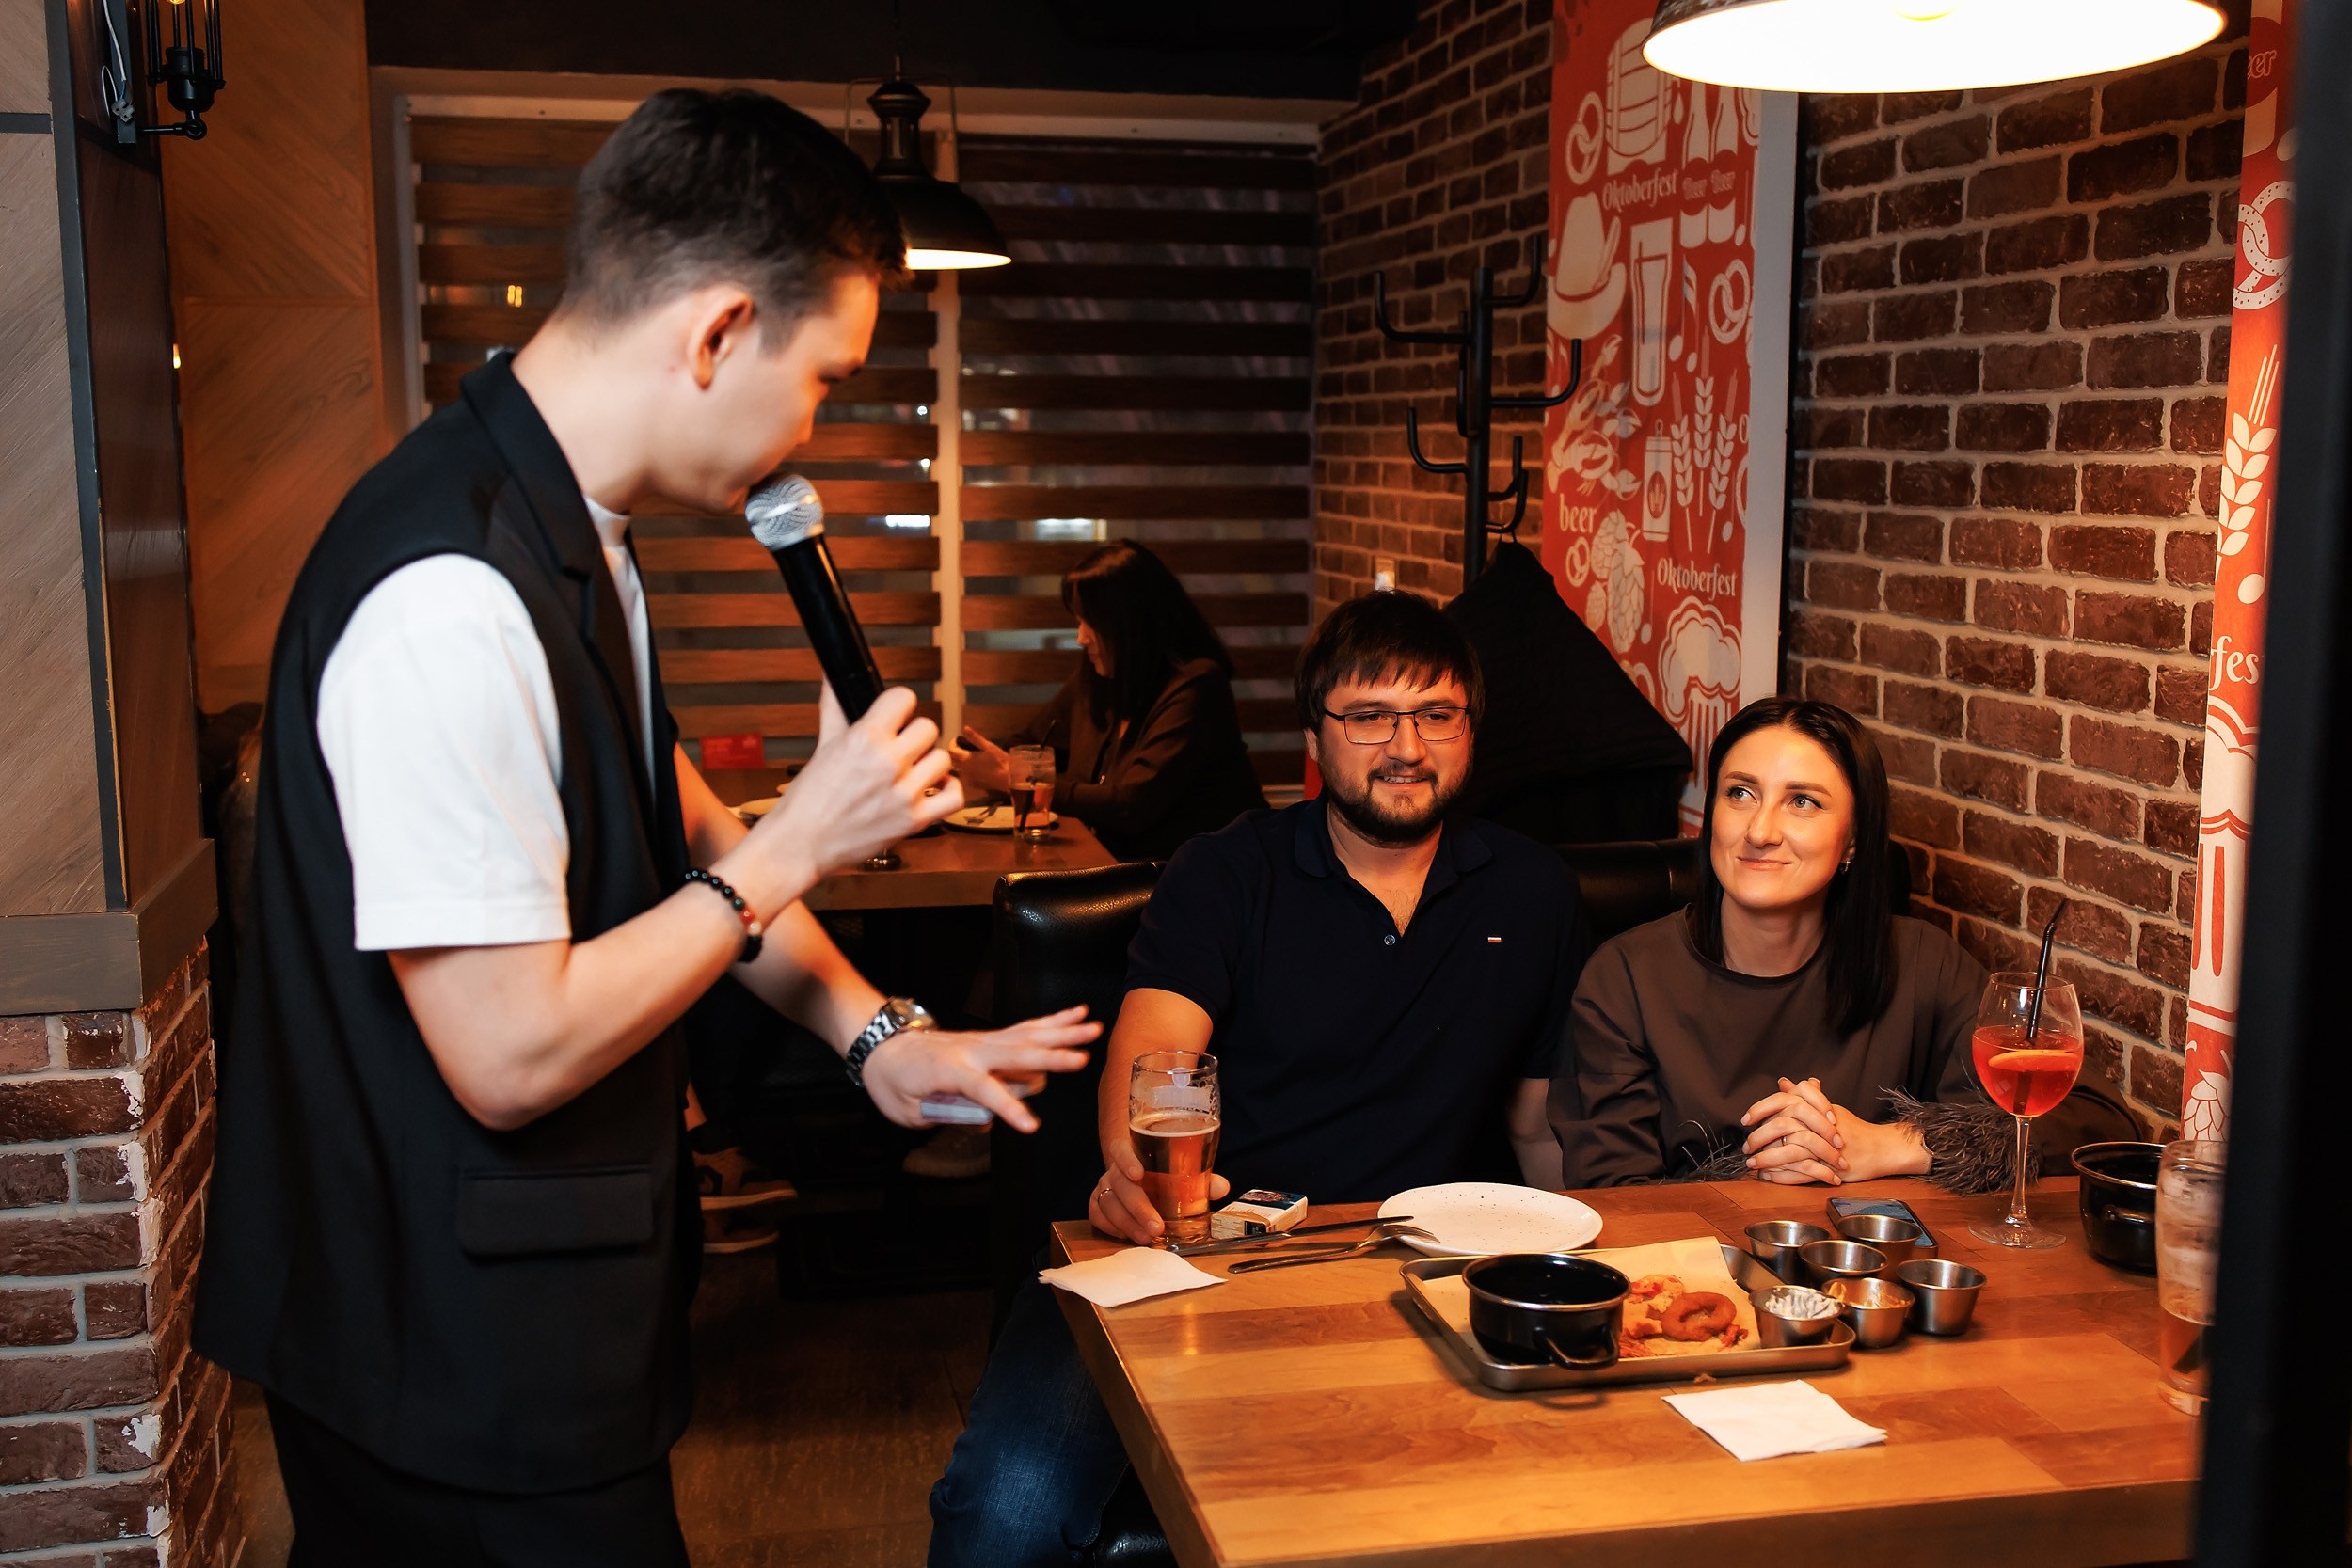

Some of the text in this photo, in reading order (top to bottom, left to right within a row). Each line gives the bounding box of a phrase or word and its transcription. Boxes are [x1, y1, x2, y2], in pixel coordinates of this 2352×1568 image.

[1602, 167, 1677, 213] Oktoberfest
[1559, 494, 1597, 533] beer
[1657, 557, 1738, 601] Oktoberfest
[2209, 635, 2259, 691] fes
